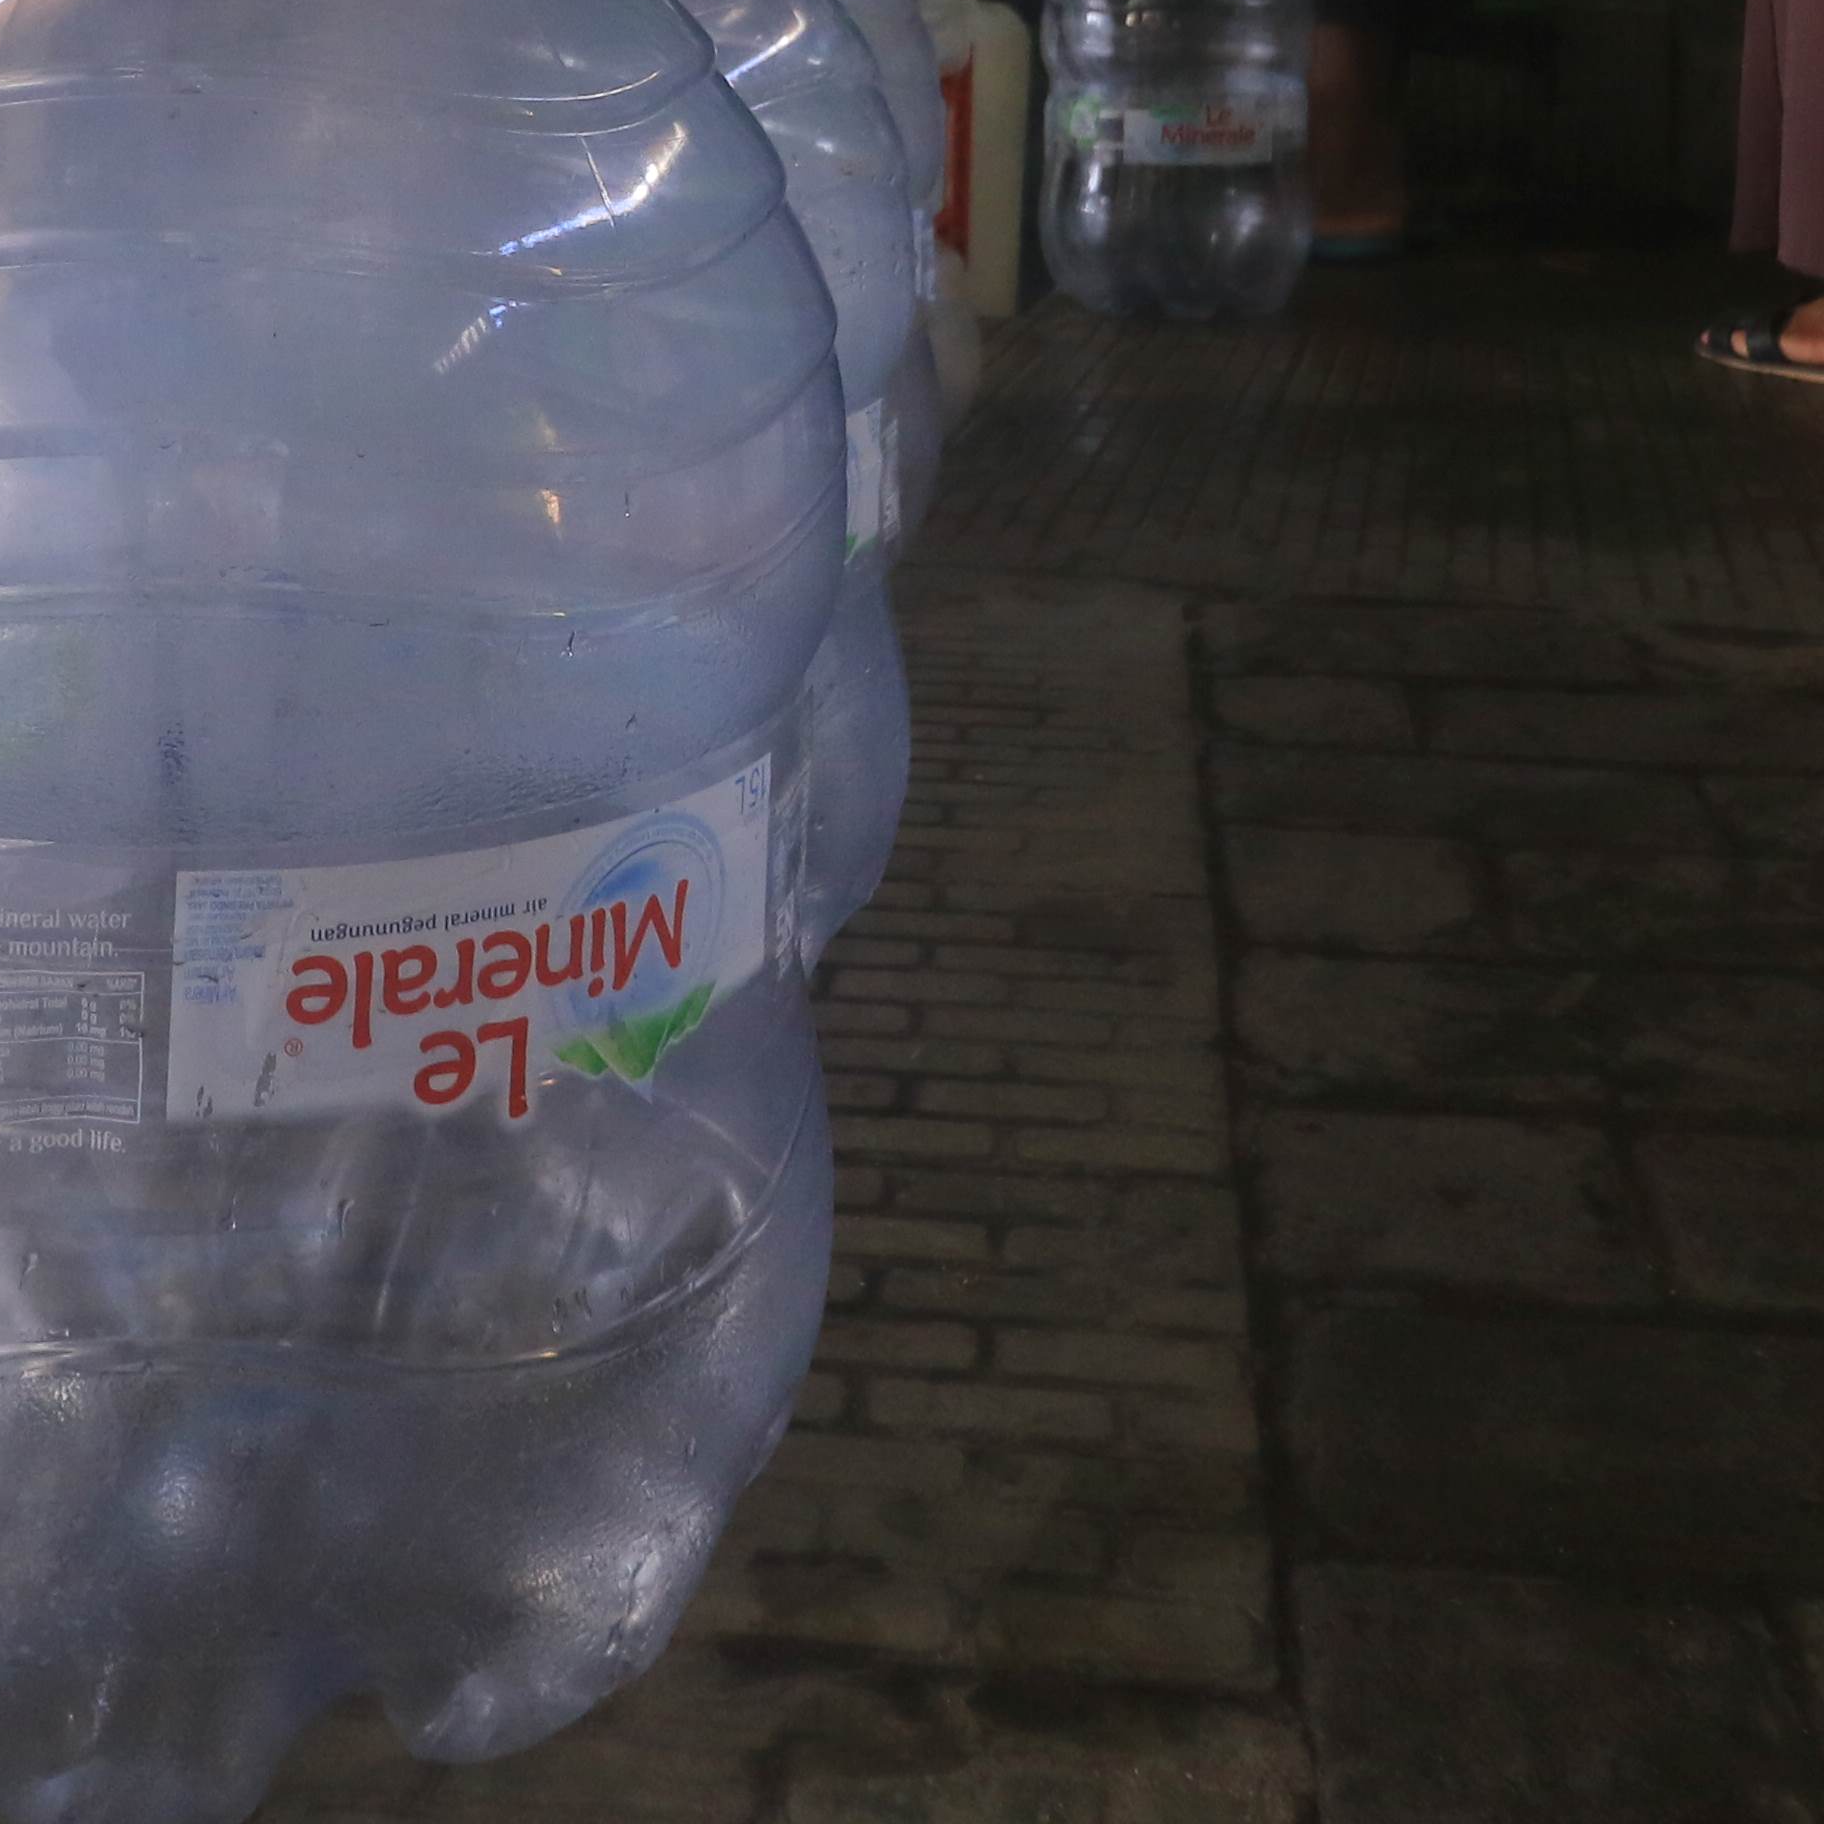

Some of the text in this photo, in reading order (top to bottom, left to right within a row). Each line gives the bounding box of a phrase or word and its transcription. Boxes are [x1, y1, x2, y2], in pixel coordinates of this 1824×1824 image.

[1206, 103, 1232, 127] Le
[68, 911, 132, 928] water
[309, 898, 548, 943] air mineral pegunungan
[9, 936, 119, 957] mountain.
[286, 881, 689, 1049] Minerale
[414, 1018, 529, 1118] Le
[9, 1138, 22, 1152] a
[30, 1128, 83, 1154] good
[90, 1128, 127, 1154] life.
